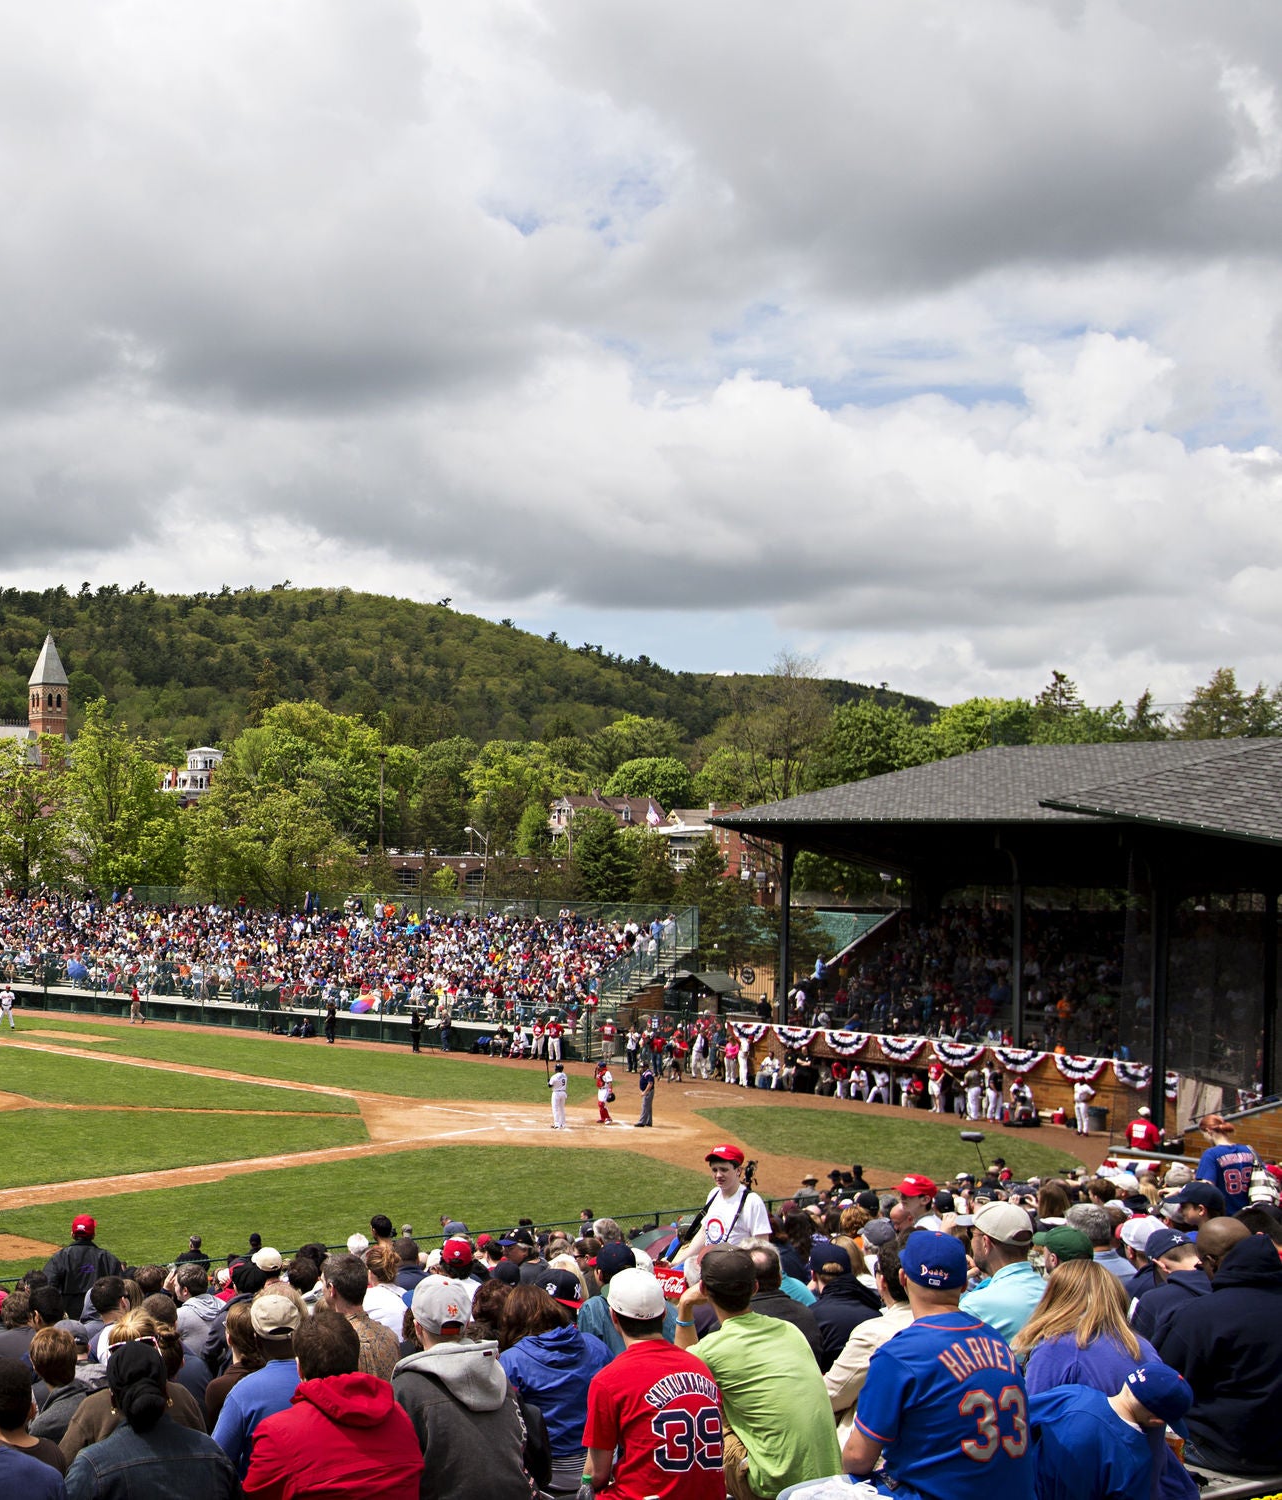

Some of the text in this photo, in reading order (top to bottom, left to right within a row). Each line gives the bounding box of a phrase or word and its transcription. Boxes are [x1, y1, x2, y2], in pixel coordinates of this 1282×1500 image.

[920, 1264, 949, 1280] Daddy
[938, 1336, 1016, 1383] HARVEY
[644, 1372, 718, 1410] SALTALAMACCHI
[651, 1406, 724, 1473] 39
[958, 1385, 1028, 1462] 33
